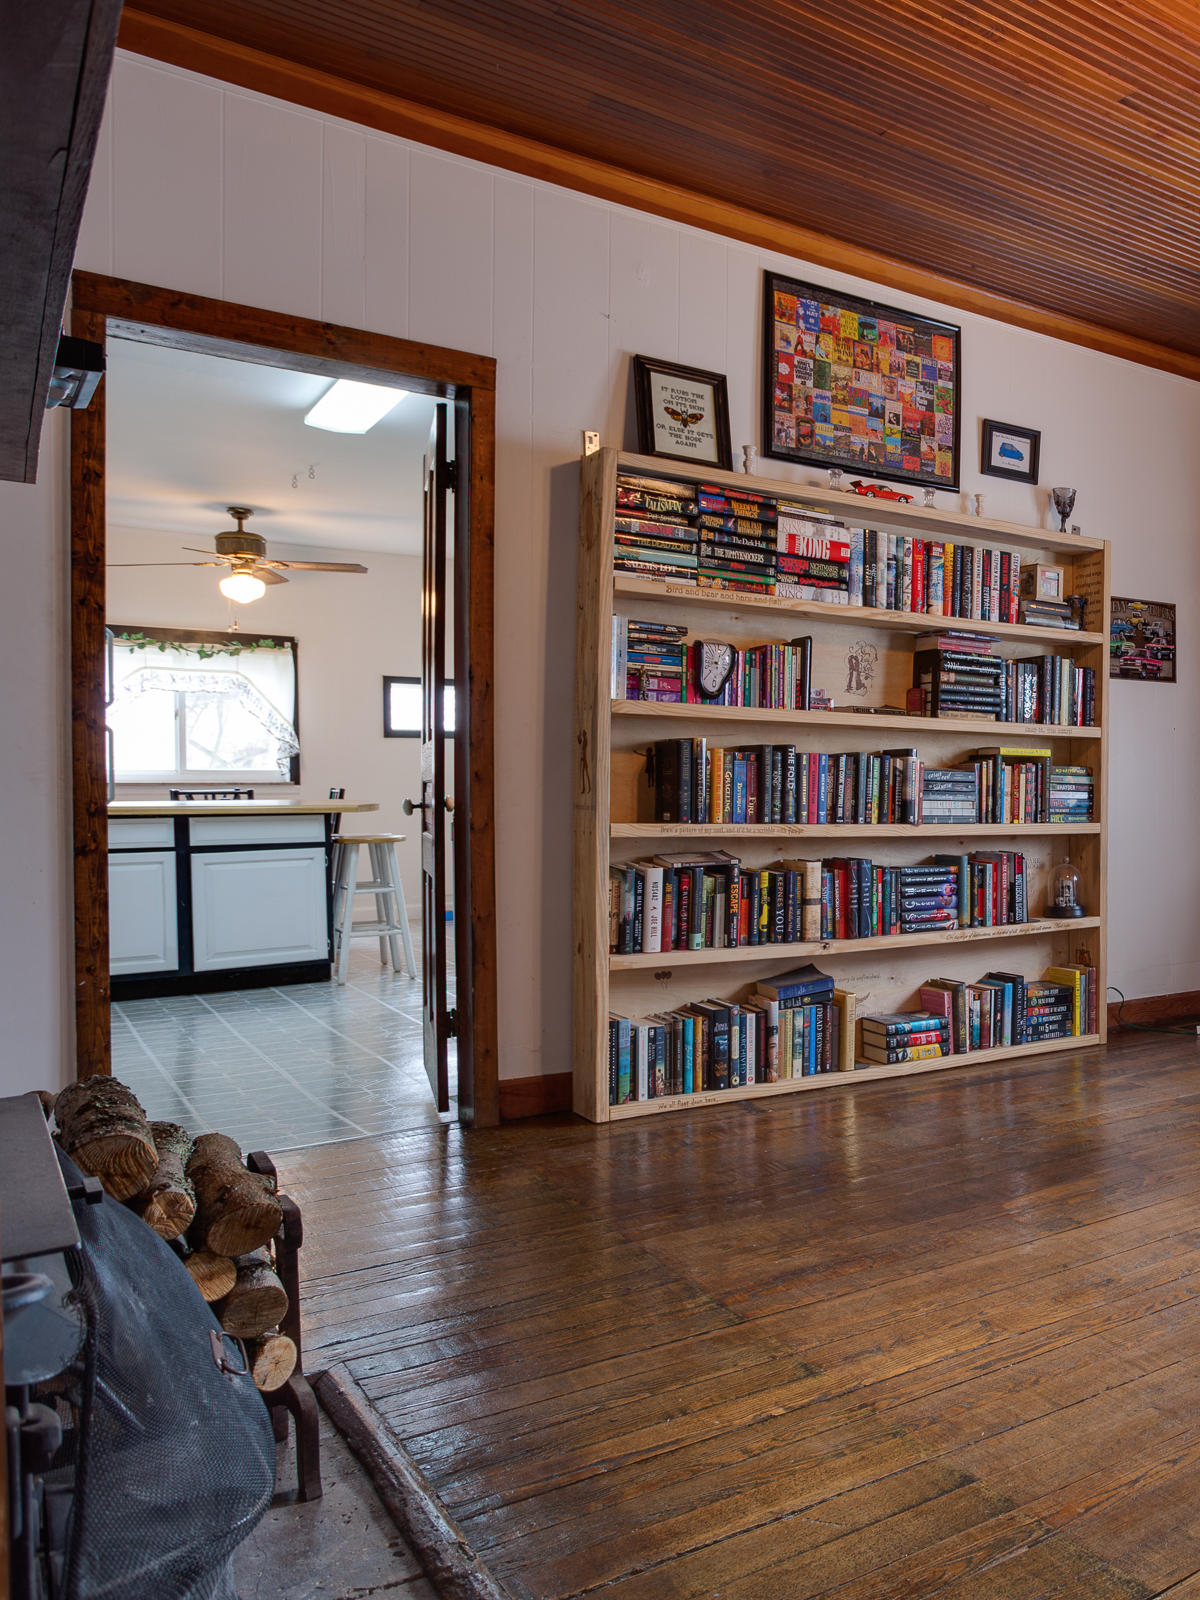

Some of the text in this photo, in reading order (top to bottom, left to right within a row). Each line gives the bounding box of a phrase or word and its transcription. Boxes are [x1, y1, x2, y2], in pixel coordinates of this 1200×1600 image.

[806, 310, 818, 318] HAT
[670, 388, 689, 397] RUBS
[691, 392, 704, 400] THE
[670, 394, 697, 404] LOTION
[689, 404, 704, 412] SKIN
[656, 423, 666, 431] OR
[669, 425, 685, 434] ELSE
[697, 431, 713, 439] GETS
[668, 432, 702, 443] THE HOSE
[675, 440, 697, 448] AGAIN
[645, 494, 682, 513] TALISMAN
[731, 500, 759, 511] NEEDFUL
[733, 509, 761, 519] THINGS
[742, 538, 754, 546] Dark
[754, 540, 767, 549] Half
[800, 536, 831, 561] KING
[714, 547, 725, 557] THE
[778, 556, 809, 570] STEPHEN
[666, 584, 683, 594] Bird
[685, 588, 699, 596] and
[701, 590, 719, 598] bear
[720, 592, 734, 600] and
[778, 588, 803, 599] KING
[1149, 605, 1175, 620] TRUCKS
[786, 766, 794, 789] FOLD
[724, 771, 733, 813] GRACELING
[651, 881, 659, 901] NOS4A2
[730, 883, 739, 914] ESCAPE
[776, 909, 784, 933] YOU
[1045, 1023, 1049, 1032] 5
